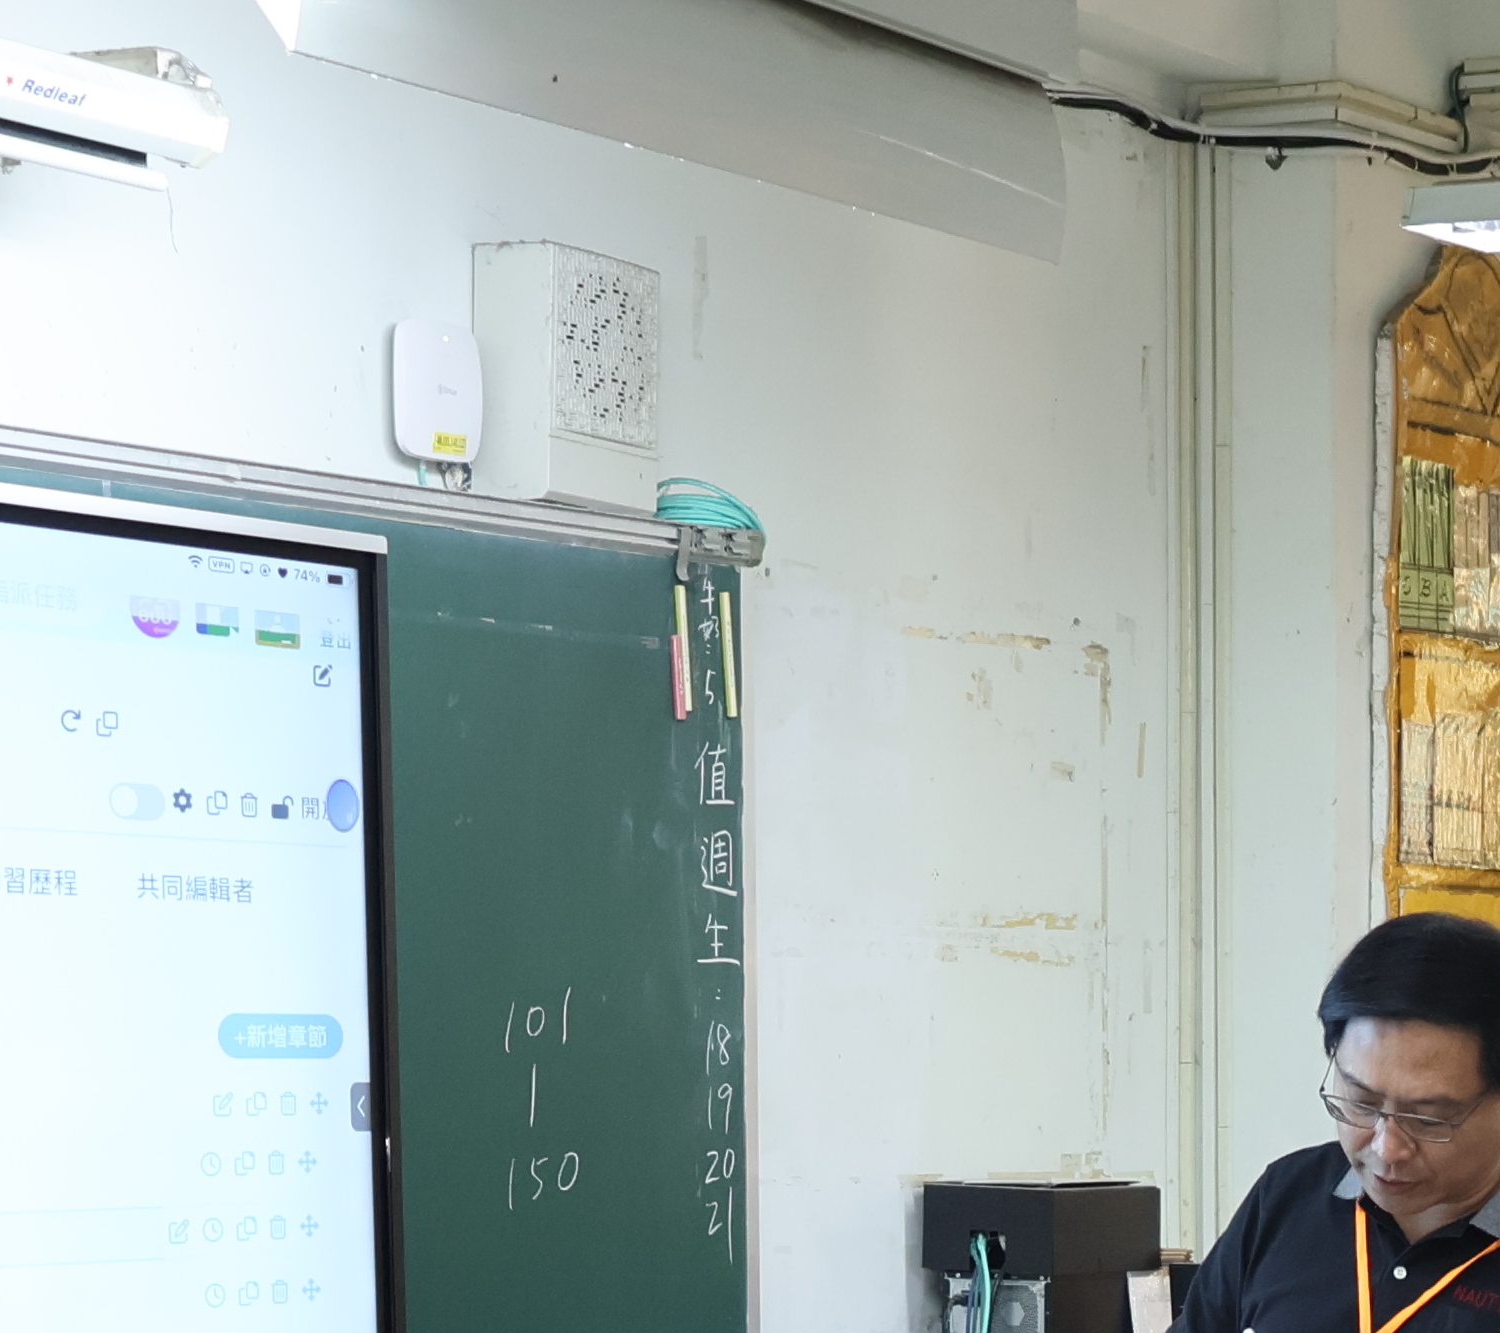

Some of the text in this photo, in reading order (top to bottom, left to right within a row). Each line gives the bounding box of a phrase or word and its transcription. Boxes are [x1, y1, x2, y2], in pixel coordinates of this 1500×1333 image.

[21, 79, 87, 106] Redleaf
[211, 560, 233, 571] VPN
[293, 567, 322, 584] 74%
[301, 796, 333, 821] 開
[136, 872, 255, 905] 共同編輯者
[706, 1020, 731, 1074] 18
[708, 1083, 733, 1132] 19
[509, 1150, 579, 1210] 150
[706, 1147, 735, 1184] 20
[706, 1186, 733, 1262] 21
